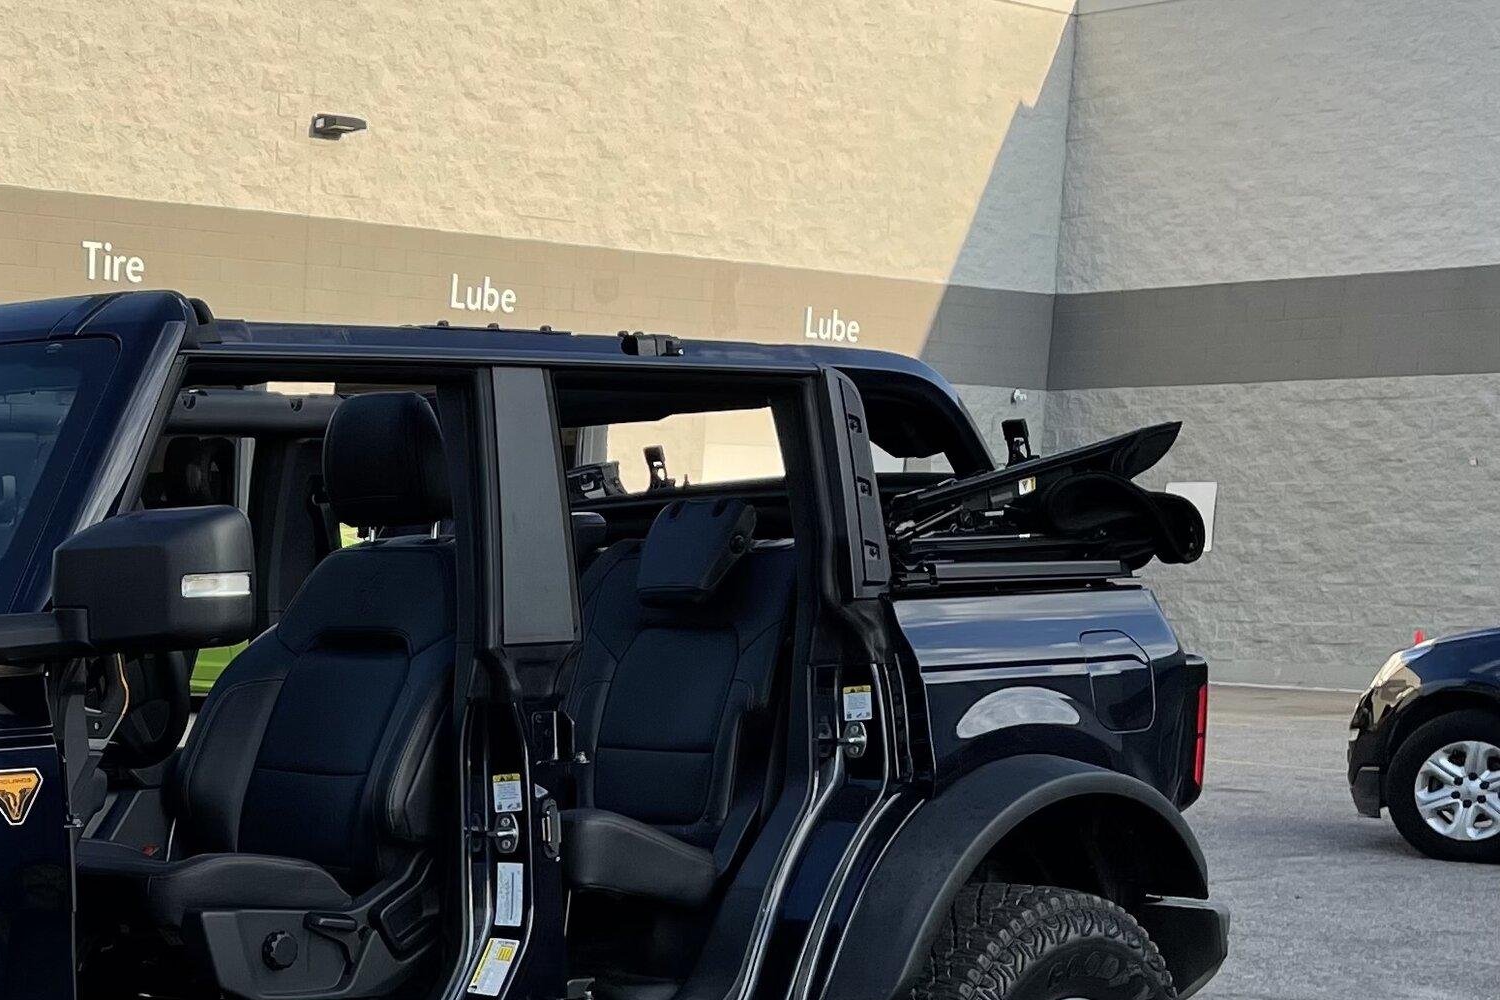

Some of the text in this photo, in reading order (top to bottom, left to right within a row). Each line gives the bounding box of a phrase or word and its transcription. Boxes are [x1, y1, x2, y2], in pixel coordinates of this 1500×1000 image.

[81, 240, 145, 283] Tire
[451, 273, 517, 313] Lube
[805, 306, 860, 343] Lube
